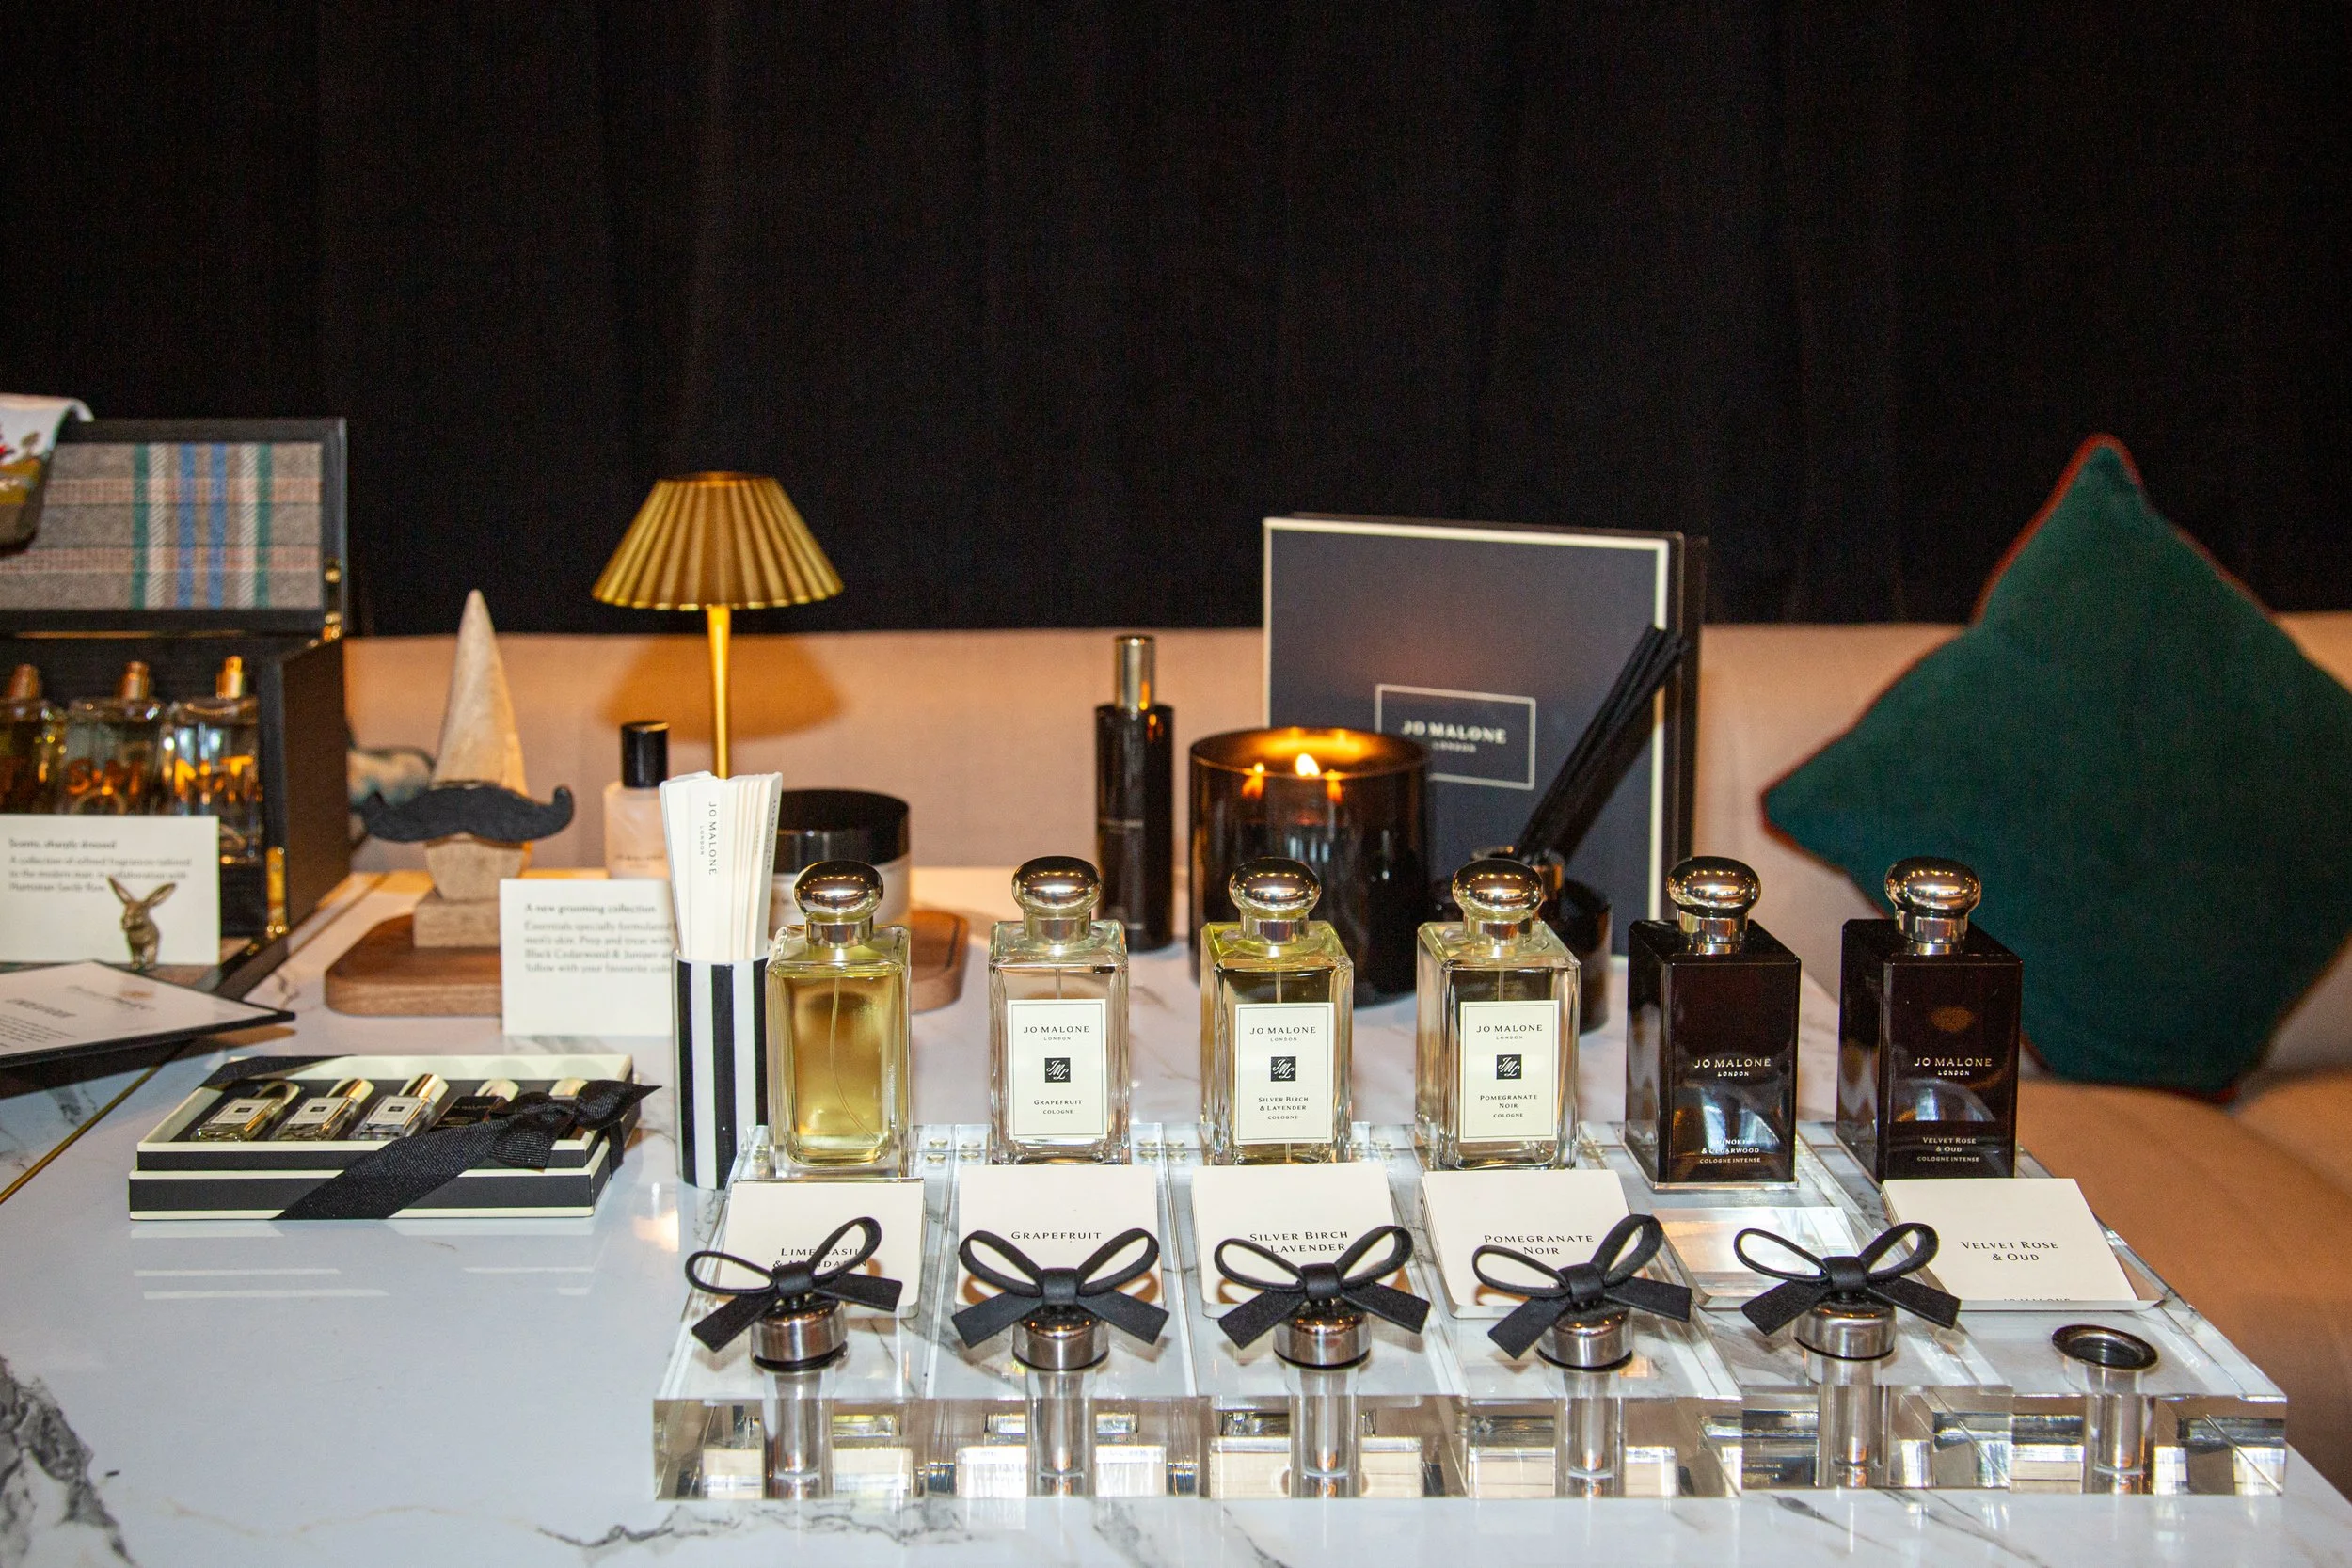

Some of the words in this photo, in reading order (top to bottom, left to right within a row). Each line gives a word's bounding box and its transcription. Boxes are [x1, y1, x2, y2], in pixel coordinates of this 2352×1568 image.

[1401, 720, 1425, 736] JO
[1428, 721, 1506, 744] MALONE
[708, 801, 717, 817] JO
[708, 821, 718, 876] MALONE
[558, 904, 605, 915] grooming
[1024, 1025, 1038, 1034] JO
[1041, 1025, 1089, 1034] MALONE
[1267, 1026, 1317, 1035] MALONE
[1494, 1024, 1543, 1033] MALONE
[1694, 1059, 1711, 1069] JO
[1714, 1058, 1772, 1069] MALONE
[1914, 1057, 1931, 1067] JO
[1934, 1057, 1993, 1067] MALONE
[1992, 1253, 2002, 1261] &
